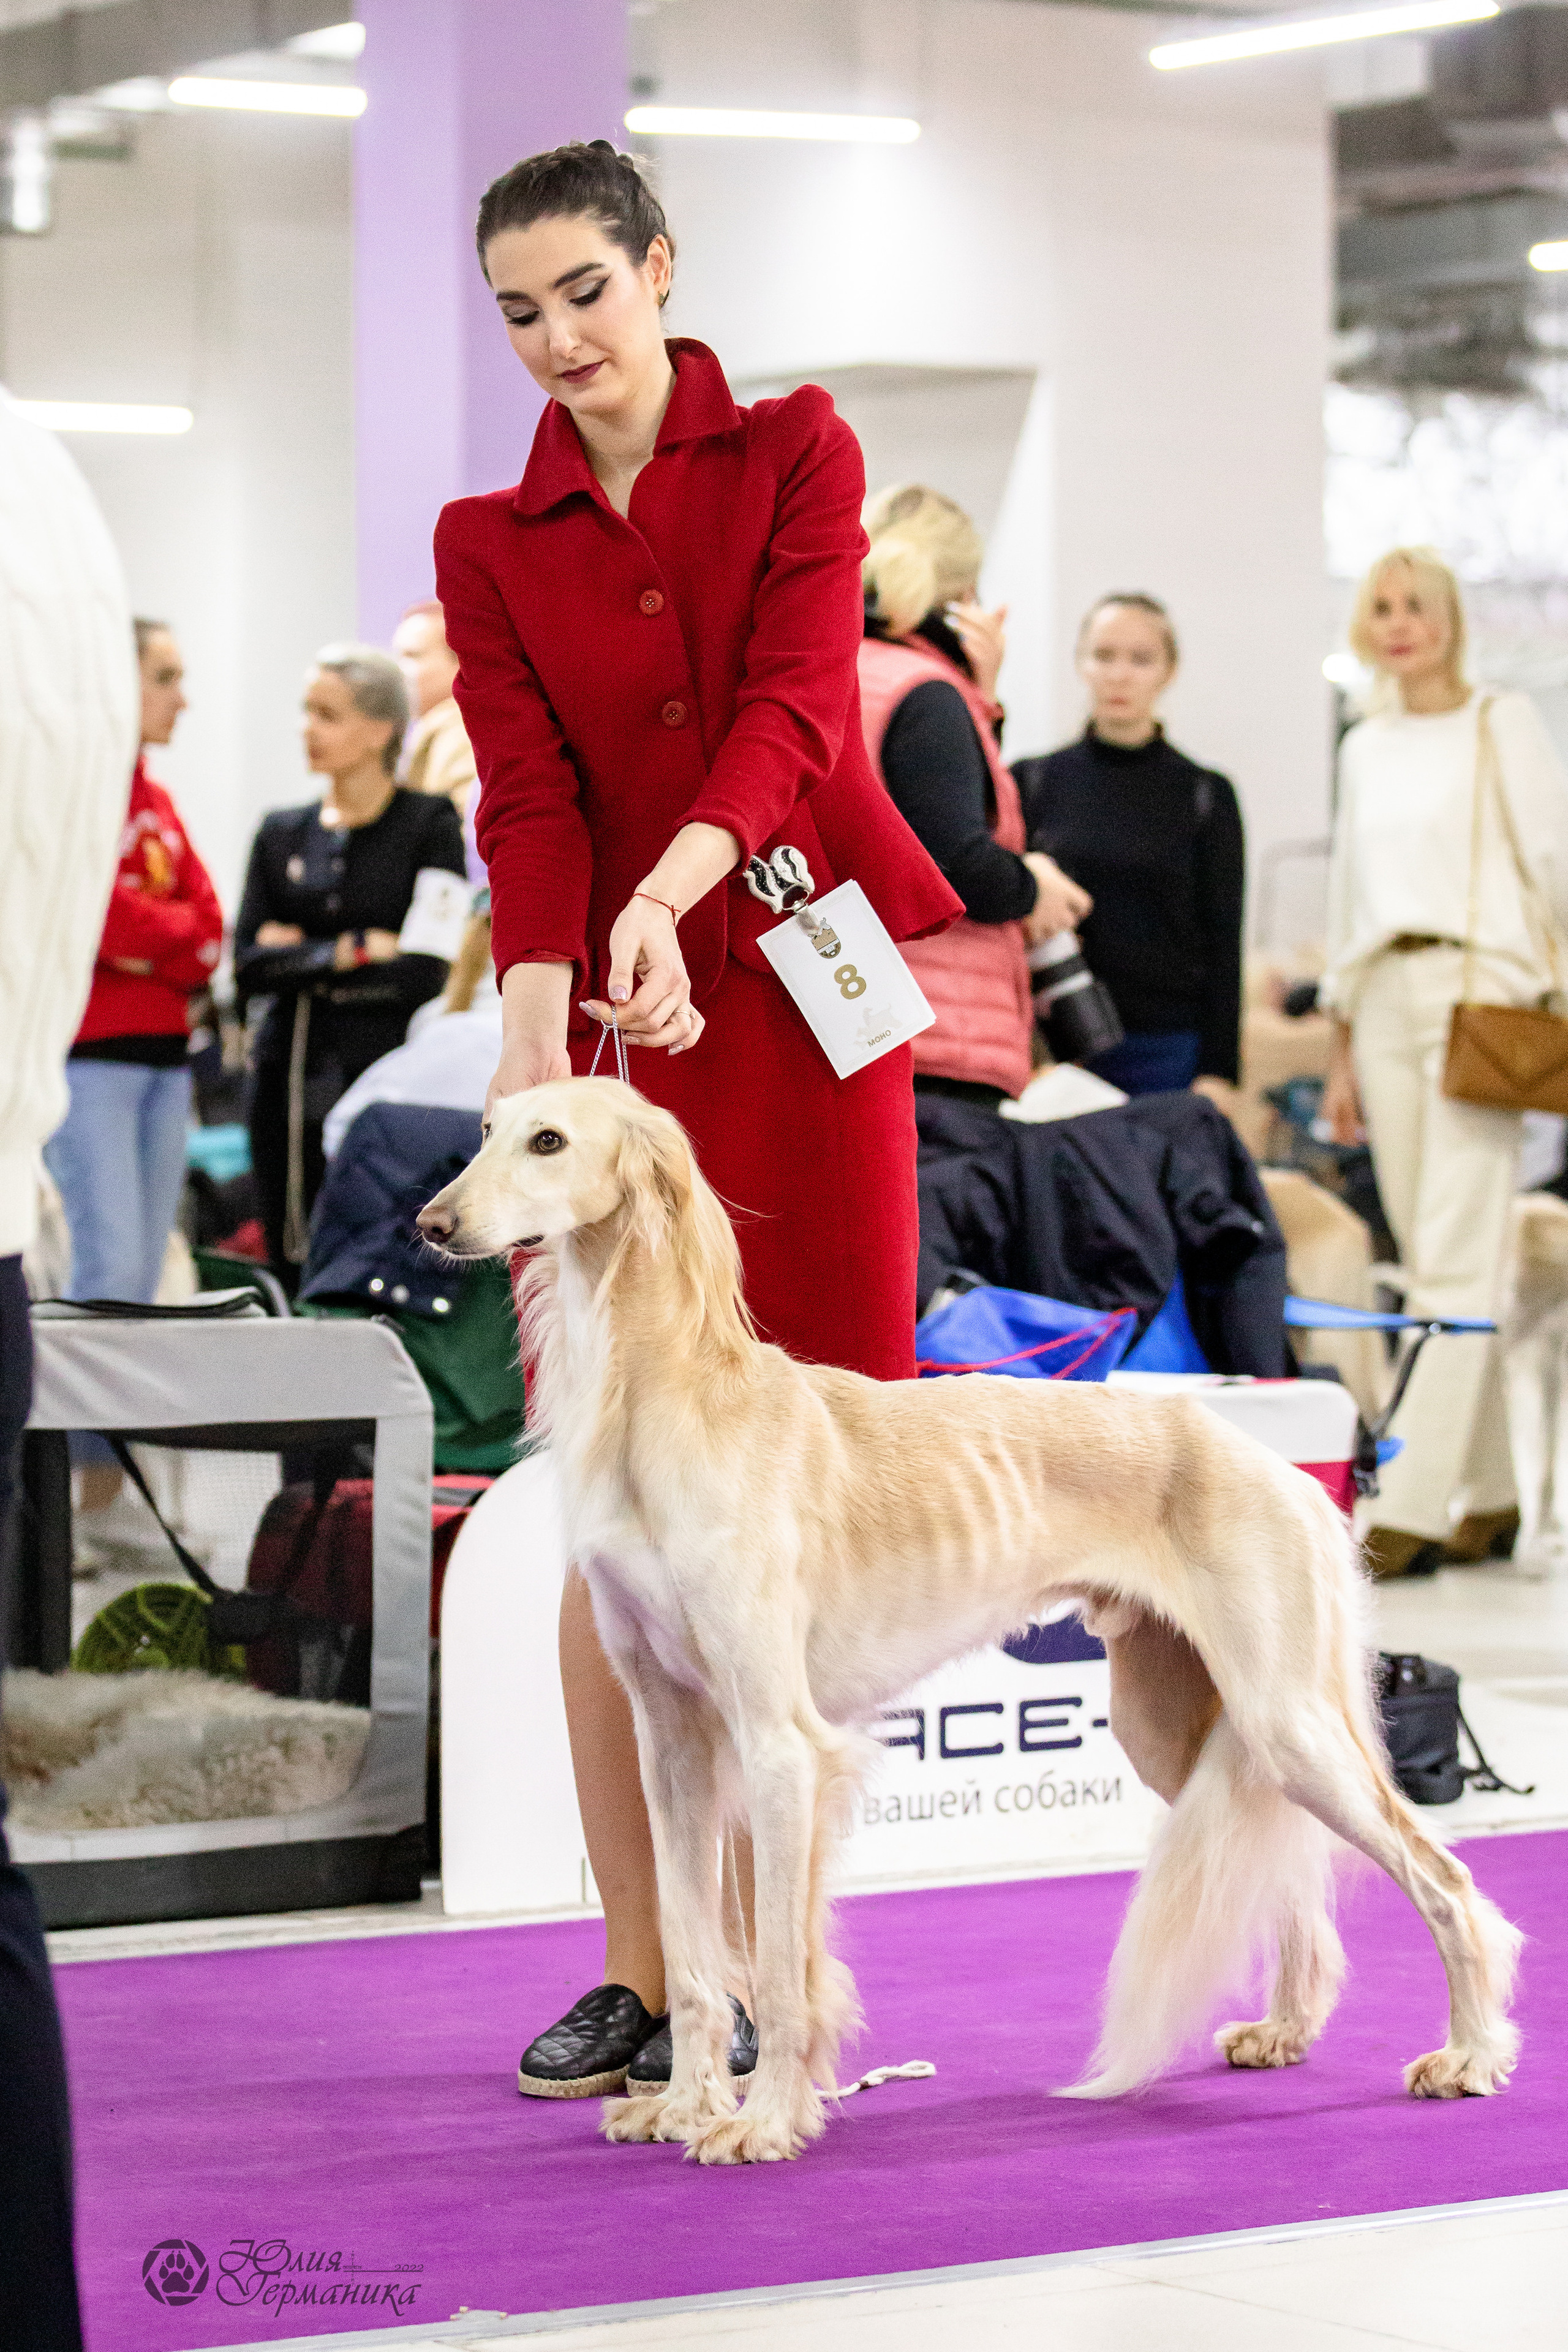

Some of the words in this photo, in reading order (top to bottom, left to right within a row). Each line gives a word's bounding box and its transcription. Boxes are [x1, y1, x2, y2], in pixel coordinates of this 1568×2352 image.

[834, 964, 867, 1000] 8
[864, 1778, 981, 1824] вашей
[994, 1769, 1122, 1813] собаки
